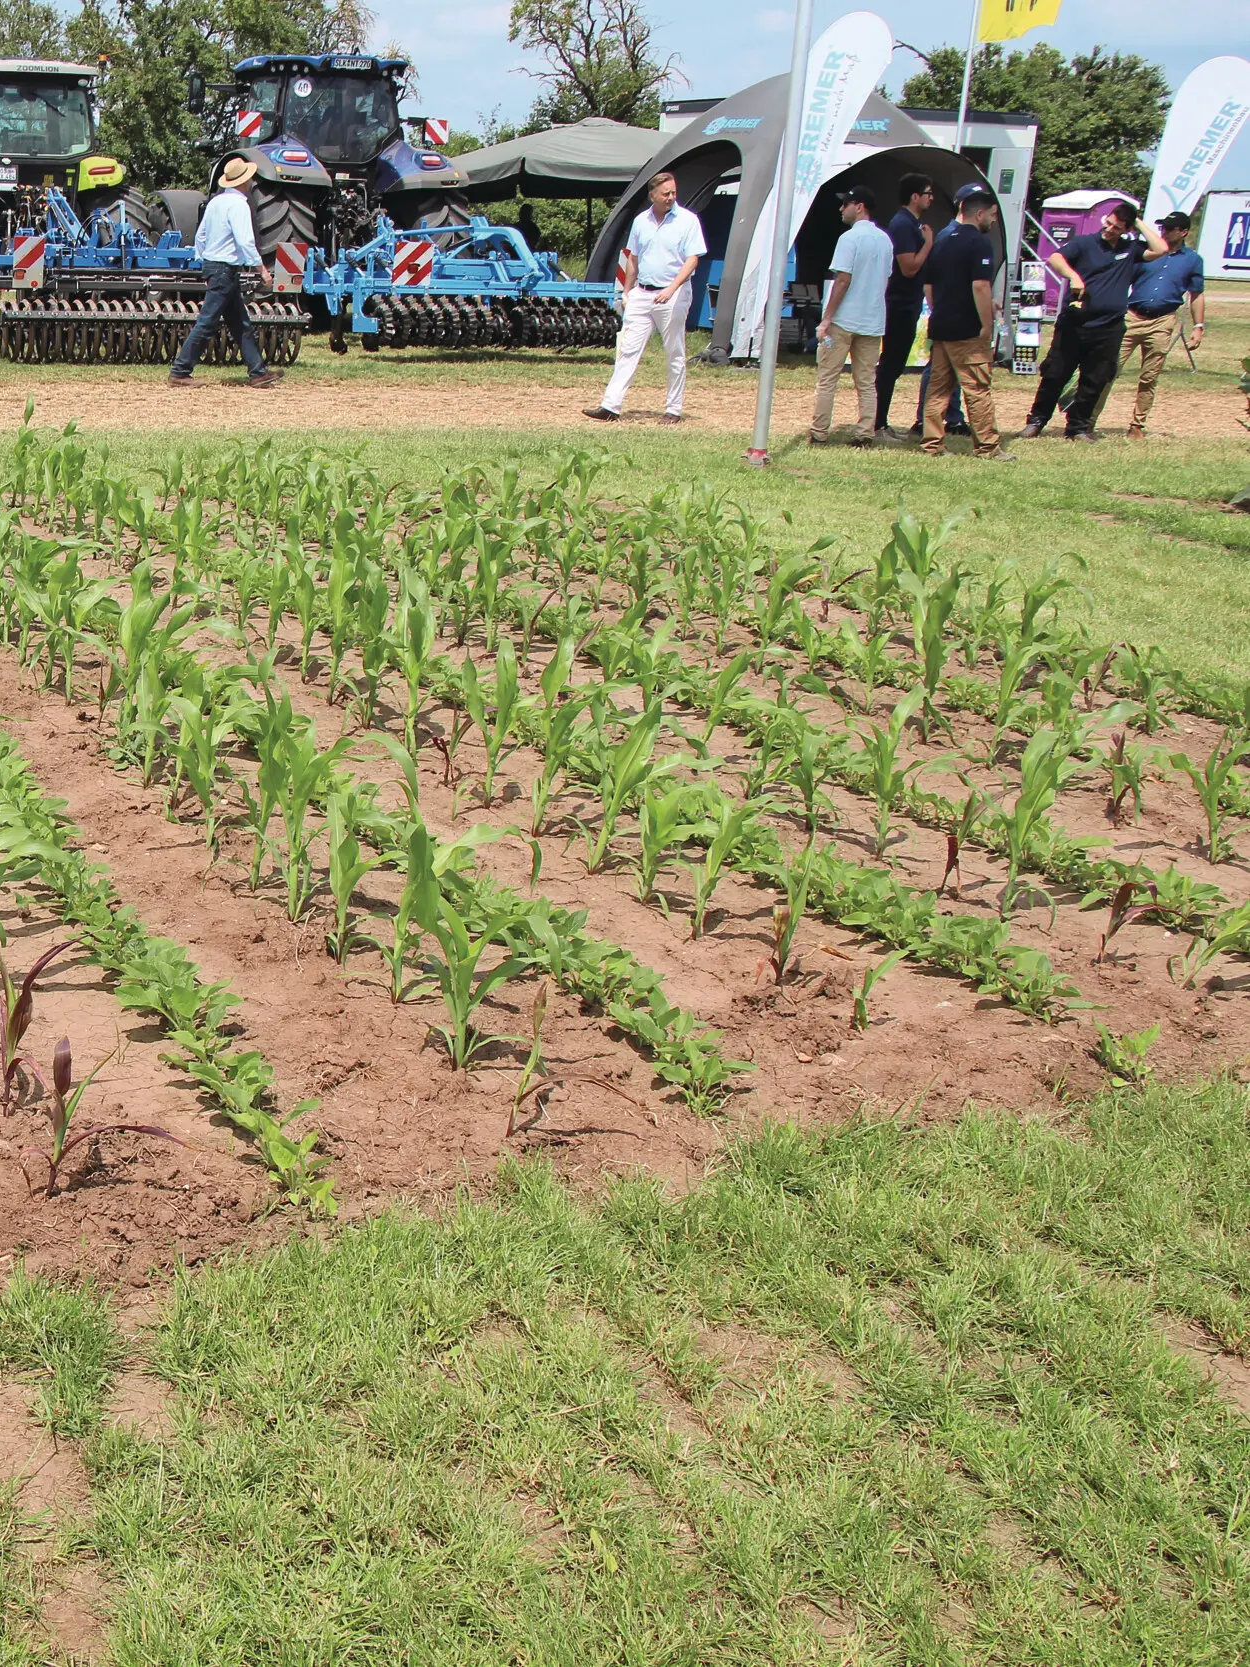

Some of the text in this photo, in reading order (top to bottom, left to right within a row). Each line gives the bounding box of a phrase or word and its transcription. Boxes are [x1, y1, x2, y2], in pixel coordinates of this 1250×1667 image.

[297, 82, 309, 94] 40
[1171, 101, 1242, 191] BREMER
[1206, 106, 1249, 165] Maschinenbau
